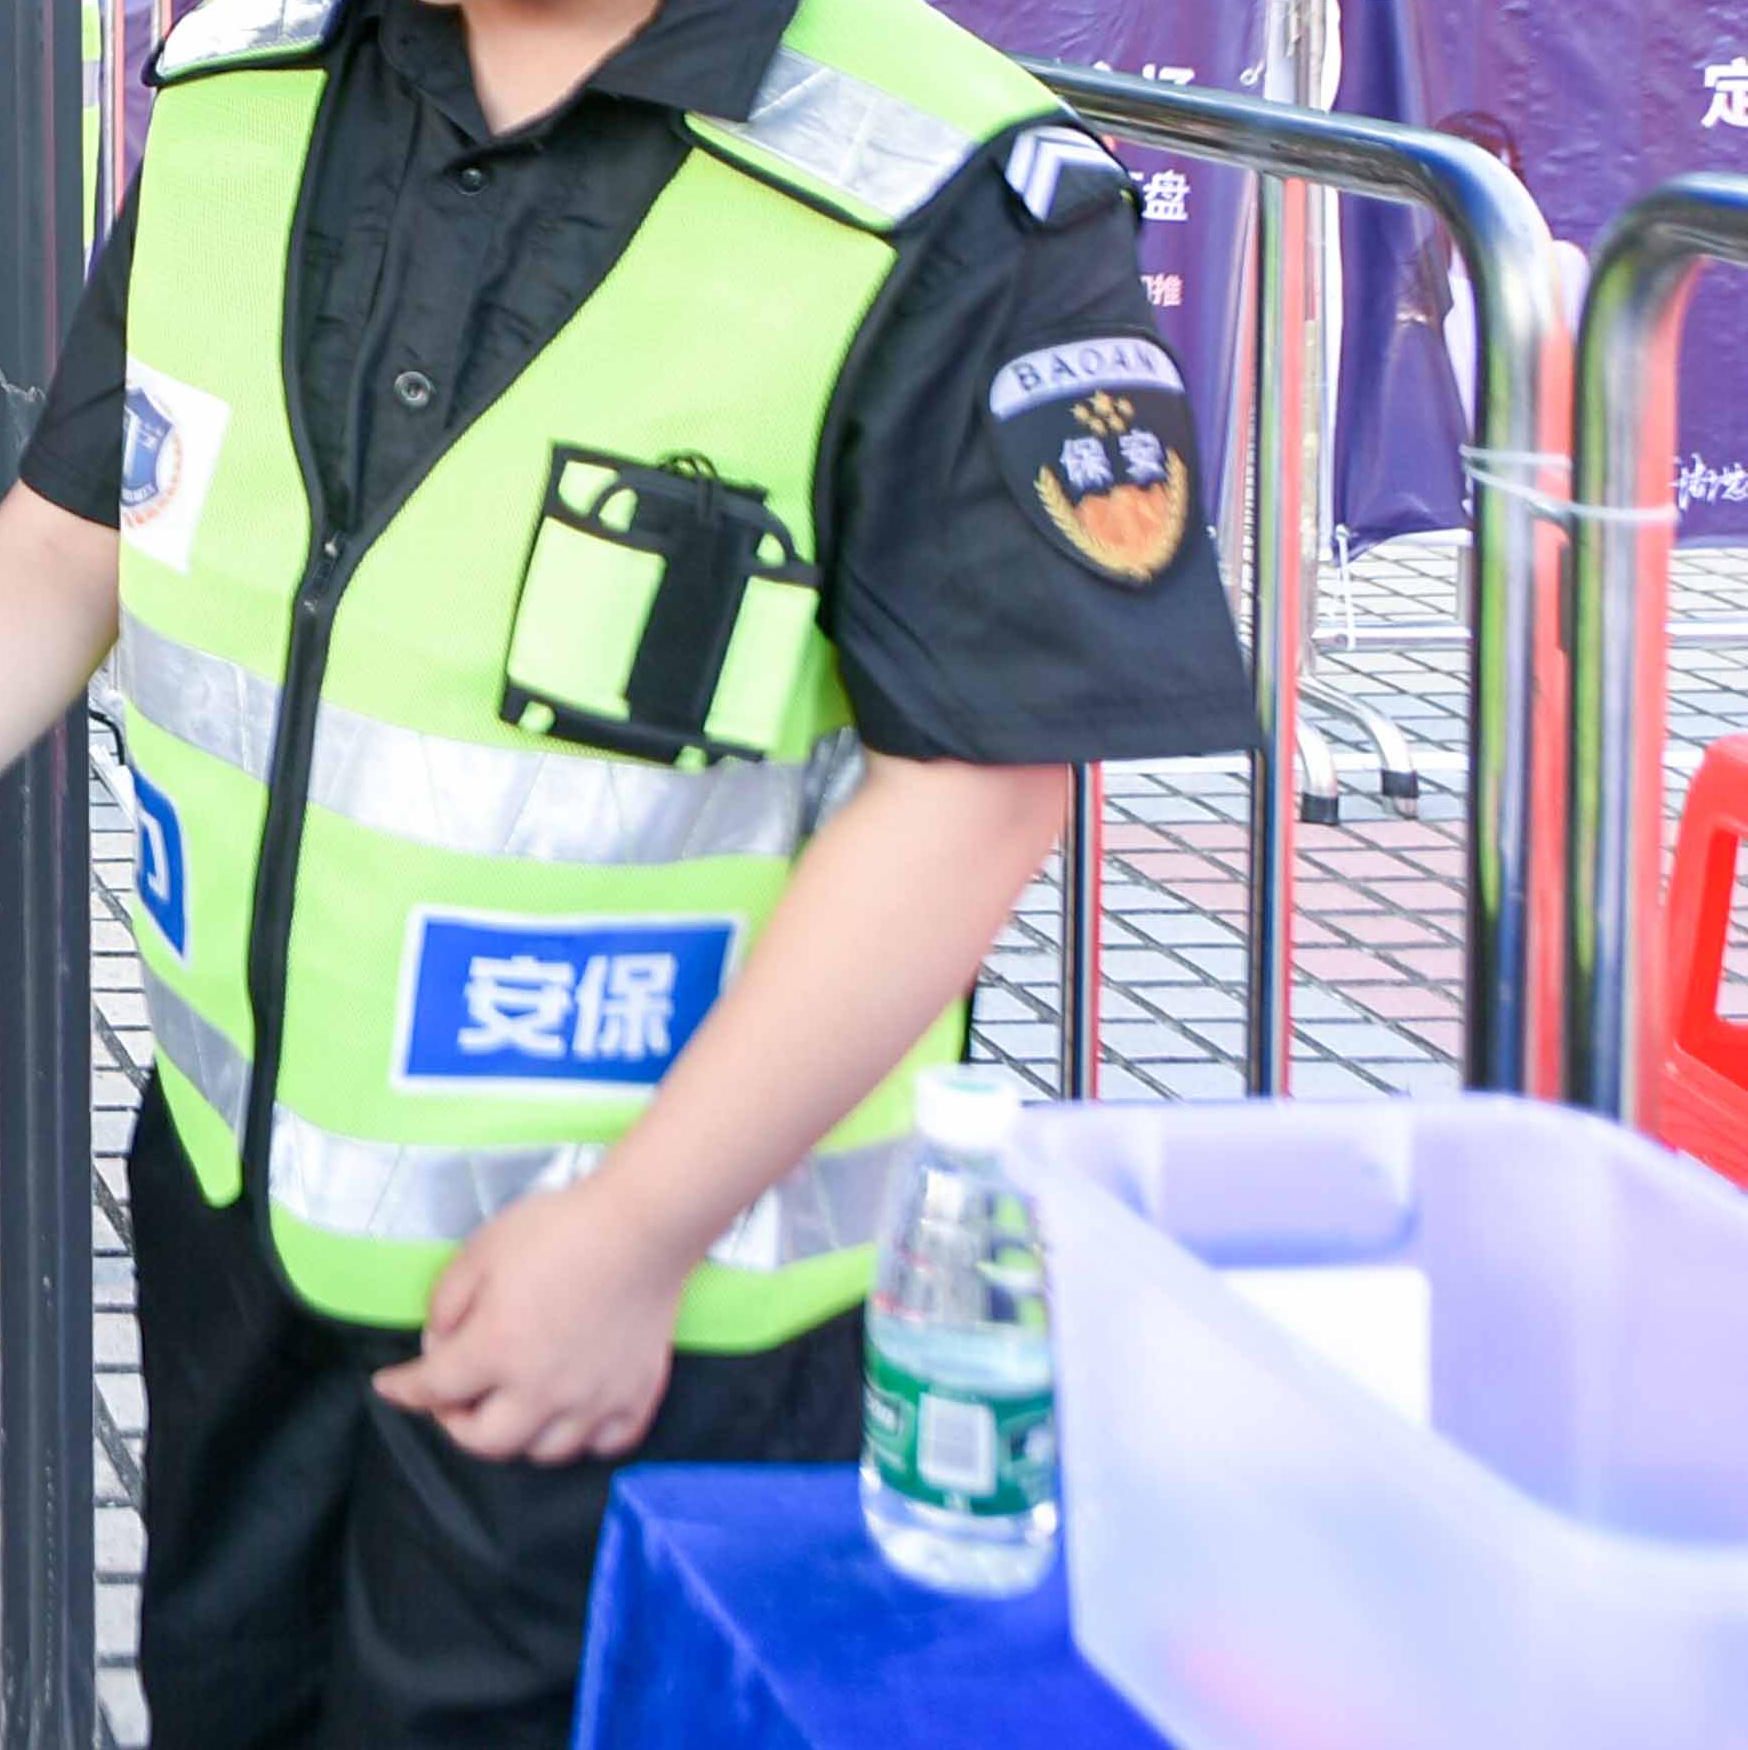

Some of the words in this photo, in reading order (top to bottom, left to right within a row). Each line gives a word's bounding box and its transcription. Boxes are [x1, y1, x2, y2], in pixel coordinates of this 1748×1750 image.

[1130, 169, 1190, 221] 盘
[1015, 341, 1159, 393] BAOAN
[457, 953, 680, 1063] 安保
